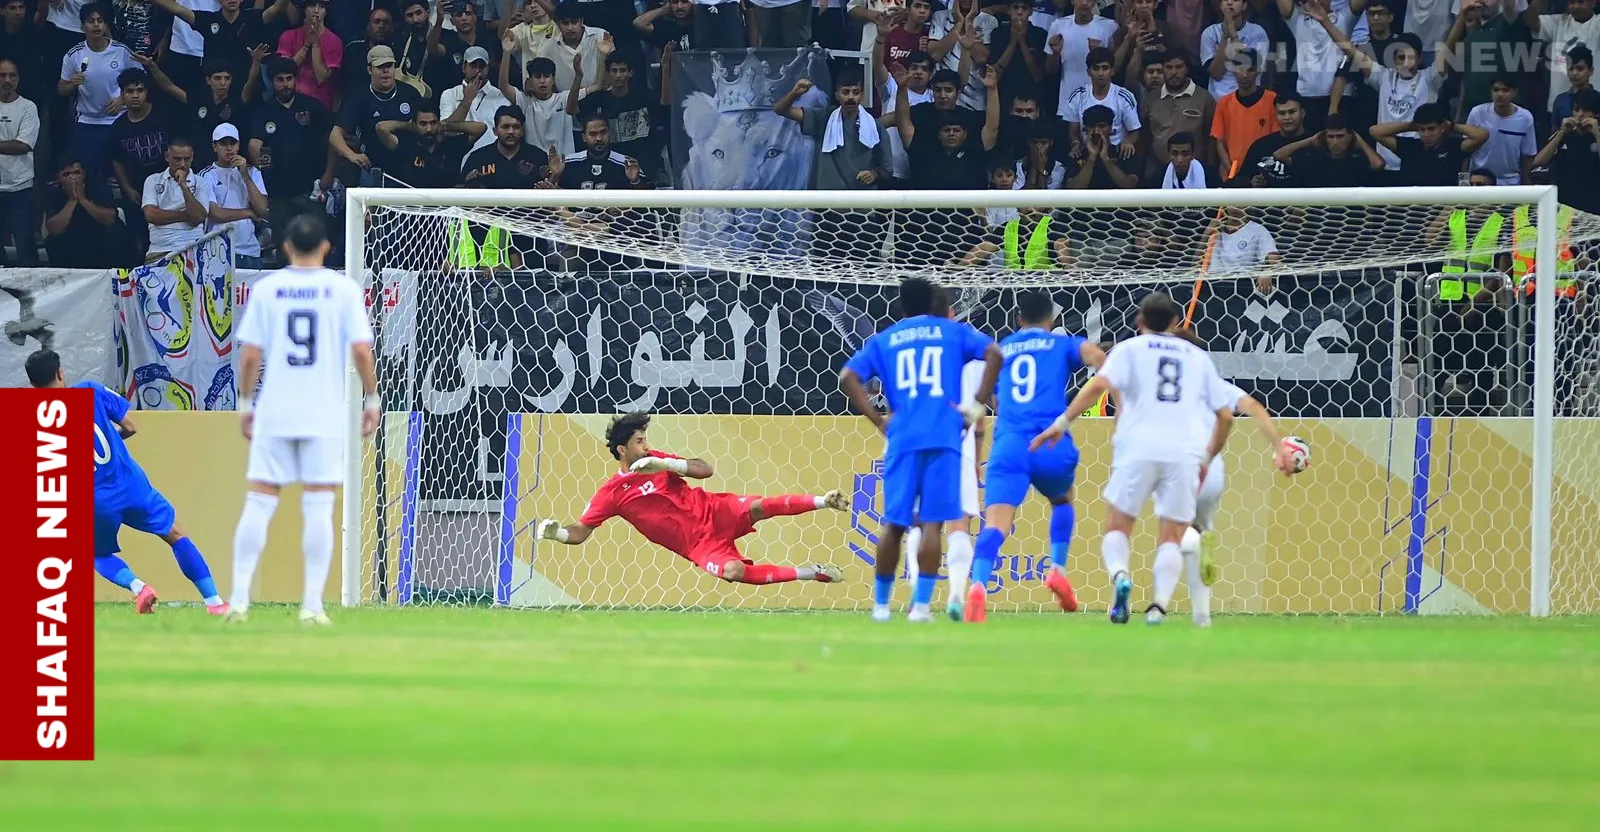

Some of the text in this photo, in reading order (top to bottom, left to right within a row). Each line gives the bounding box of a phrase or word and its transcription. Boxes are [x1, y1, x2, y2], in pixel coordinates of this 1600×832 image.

[287, 309, 318, 367] 9
[421, 300, 781, 414] النوارس
[896, 346, 944, 399] 44
[1011, 354, 1037, 403] 9
[1157, 356, 1182, 402] 8
[638, 480, 657, 496] 12
